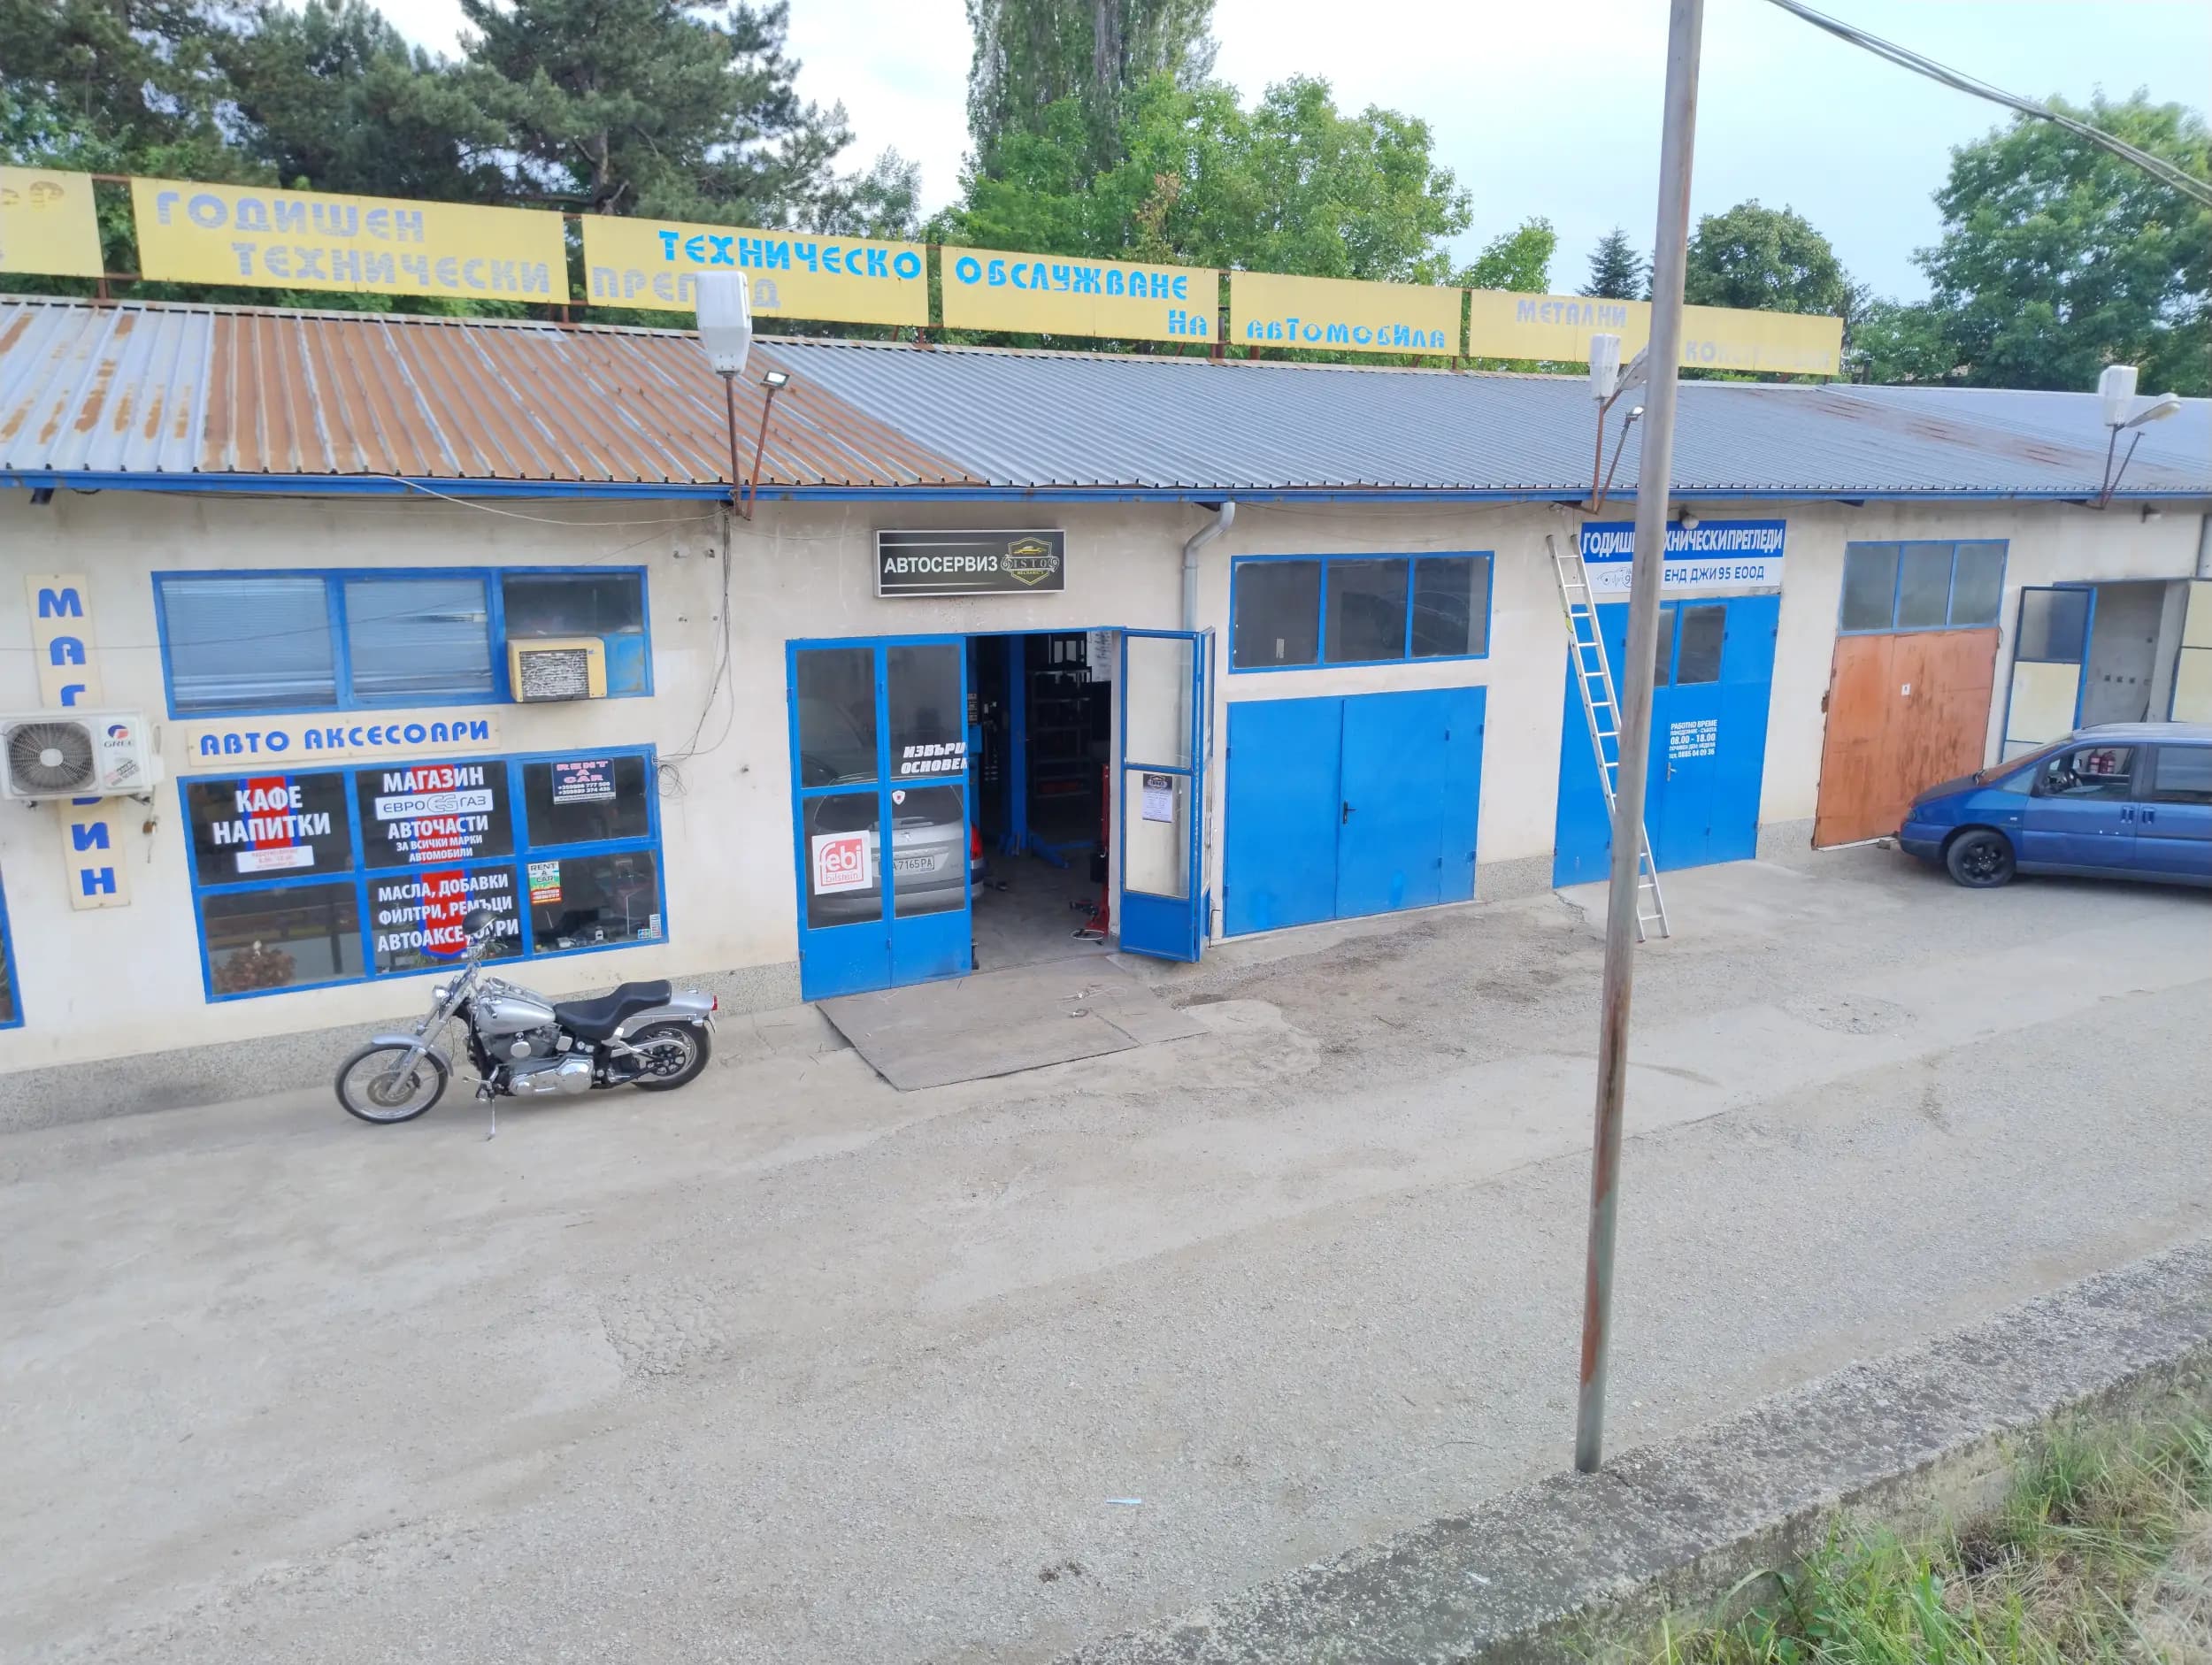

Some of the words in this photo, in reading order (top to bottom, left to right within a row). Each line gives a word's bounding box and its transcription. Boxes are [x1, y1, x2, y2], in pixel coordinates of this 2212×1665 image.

[157, 190, 425, 242] ГОДИШЕН
[231, 241, 550, 294] ТЕХНИЧЕСКИ
[658, 229, 922, 280] ТЕХНИЧЕСКО
[592, 266, 782, 309] ПРЕГД
[956, 256, 1188, 302] ОБСЛУЖВАНЕ
[1169, 309, 1208, 337] НА
[1517, 299, 1628, 327] МЕТАЛНИ
[1247, 317, 1446, 349] АВТОМОБИЛА
[1582, 532, 1635, 557] ГОДИШ
[1663, 529, 1729, 551] ХНИЧЕСКИ
[885, 556, 998, 573] АВТОСЕРВИЗ
[1664, 569, 1687, 583] ЕНД
[1718, 566, 1732, 580] 95
[1734, 565, 1764, 581] ЕООД
[38, 587, 117, 896] МАГИН
[200, 730, 290, 756] АВТО
[304, 720, 489, 750] АКСЕСОАРИ
[1696, 733, 1716, 743] 18.00
[383, 766, 485, 793] МАГАЗИН
[557, 761, 609, 771] RENT
[564, 774, 603, 784] CAR
[235, 785, 303, 814] КАФЕ
[460, 795, 486, 808] ГАЗ
[212, 812, 332, 846] НАПИТКИ
[388, 815, 489, 840] АВТОЧАСТИ
[396, 841, 410, 852] ЗА
[411, 838, 449, 850] ВСИЧКИ
[449, 834, 483, 847] МАРКИ
[409, 848, 473, 863] АВТОМОБИЛИ
[530, 863, 556, 871] RENT
[378, 882, 436, 902] МАСЛА,
[439, 873, 509, 898] ДОБАВКИ
[378, 903, 447, 925] ФИЛТРИ,
[449, 895, 513, 917] РЕМЪЦИ
